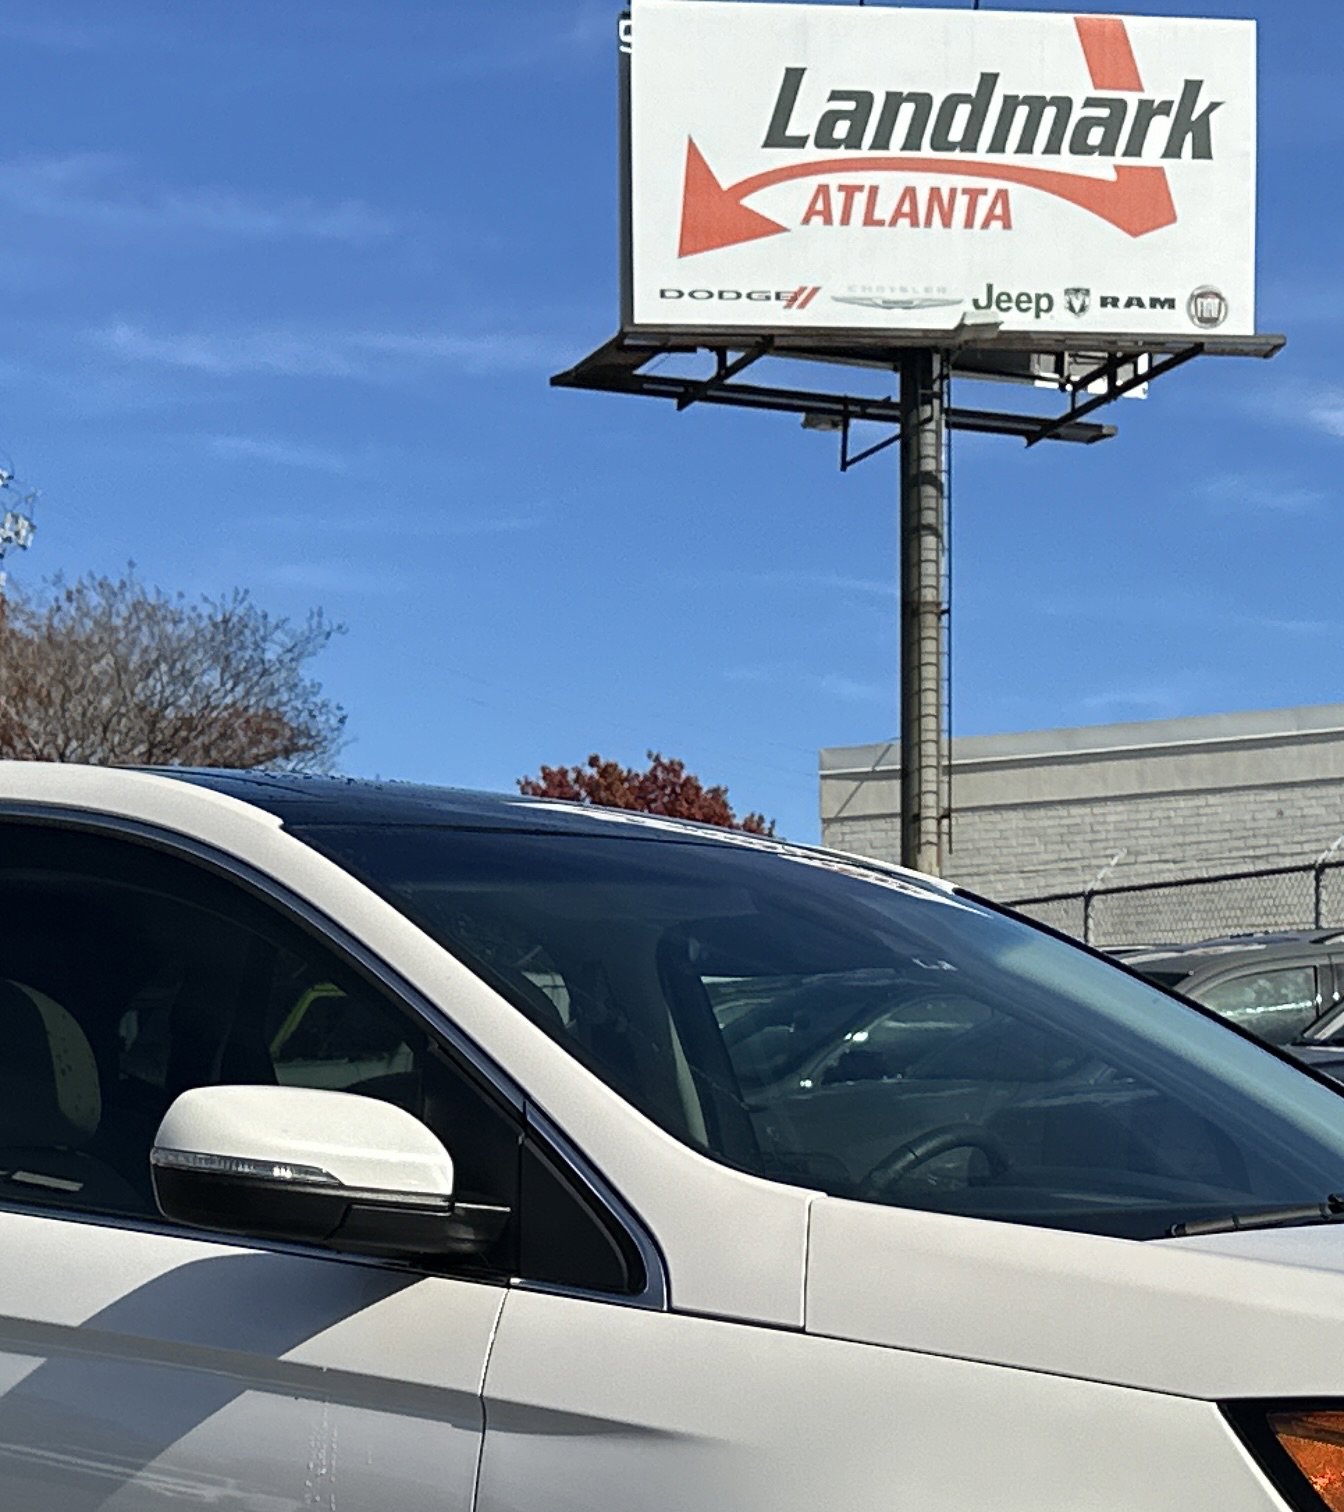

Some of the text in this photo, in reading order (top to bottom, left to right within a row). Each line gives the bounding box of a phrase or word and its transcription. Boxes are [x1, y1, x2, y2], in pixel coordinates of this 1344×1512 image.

[760, 66, 1226, 160] Landmark
[800, 183, 1013, 231] ATLANTA
[659, 288, 799, 301] DODGE
[972, 283, 1054, 319] Jeep
[1099, 295, 1176, 310] RAM
